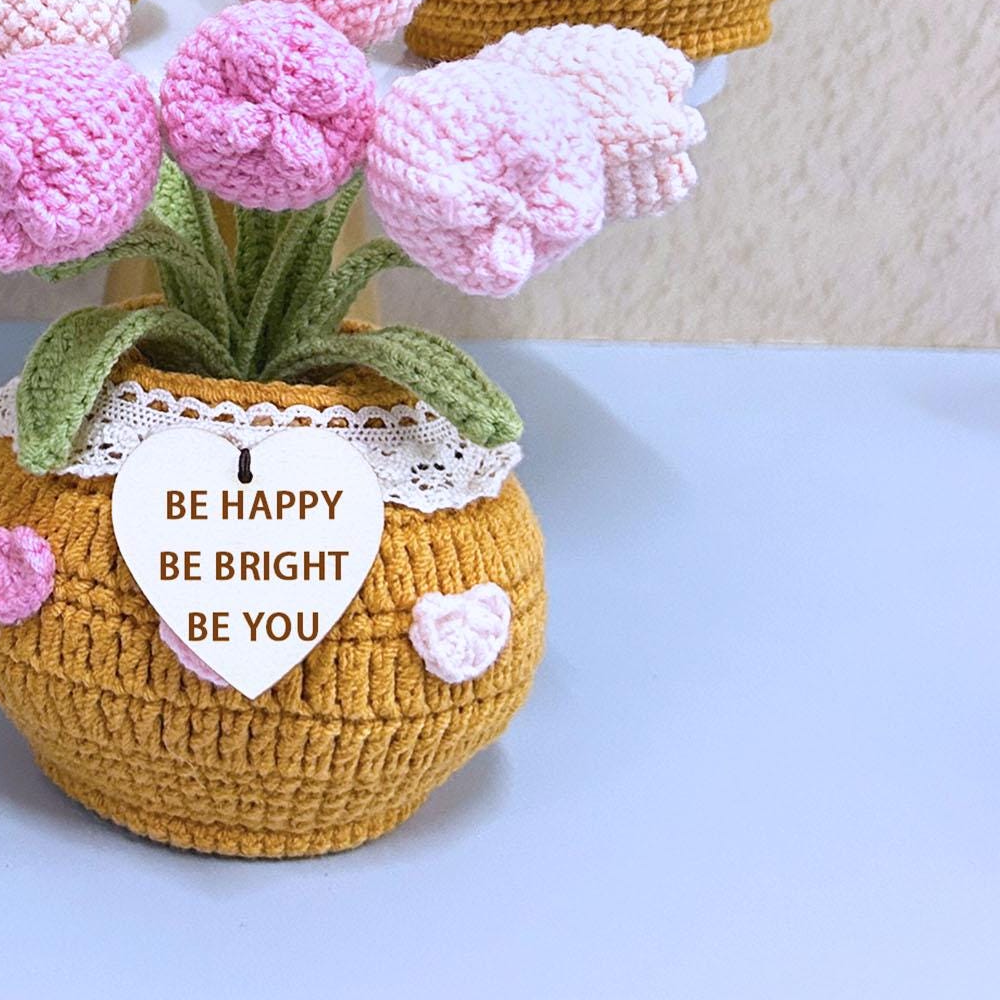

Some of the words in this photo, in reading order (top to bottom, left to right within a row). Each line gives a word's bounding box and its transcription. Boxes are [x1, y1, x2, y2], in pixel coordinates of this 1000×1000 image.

[166, 490, 208, 520] BE
[222, 490, 344, 520] HAPPY
[160, 551, 202, 581] BE
[215, 551, 349, 581] BRIGHT
[188, 612, 230, 642] BE
[243, 612, 319, 642] YOU
